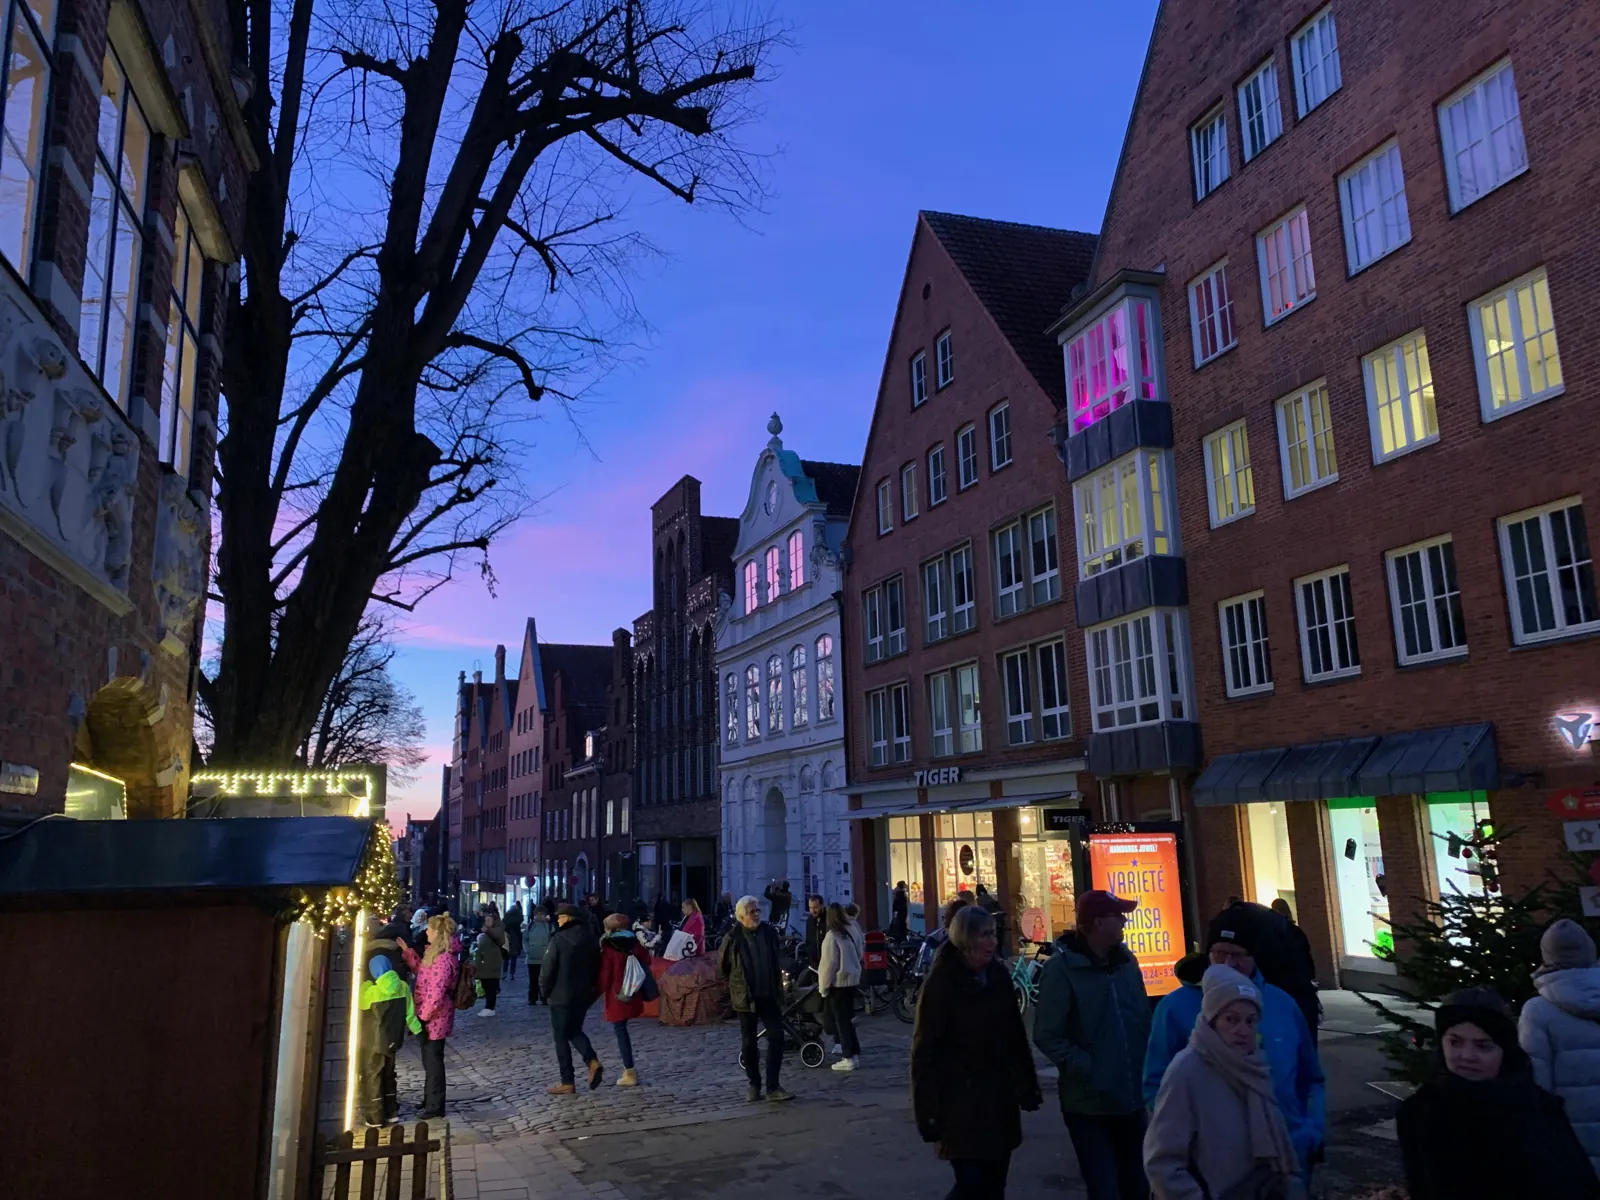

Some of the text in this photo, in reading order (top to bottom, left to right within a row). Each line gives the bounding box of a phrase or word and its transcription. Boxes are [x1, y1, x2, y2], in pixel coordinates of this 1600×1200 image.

[914, 767, 960, 787] TIGER
[1052, 815, 1086, 823] TIGER
[1107, 865, 1165, 894] VARIETÉ
